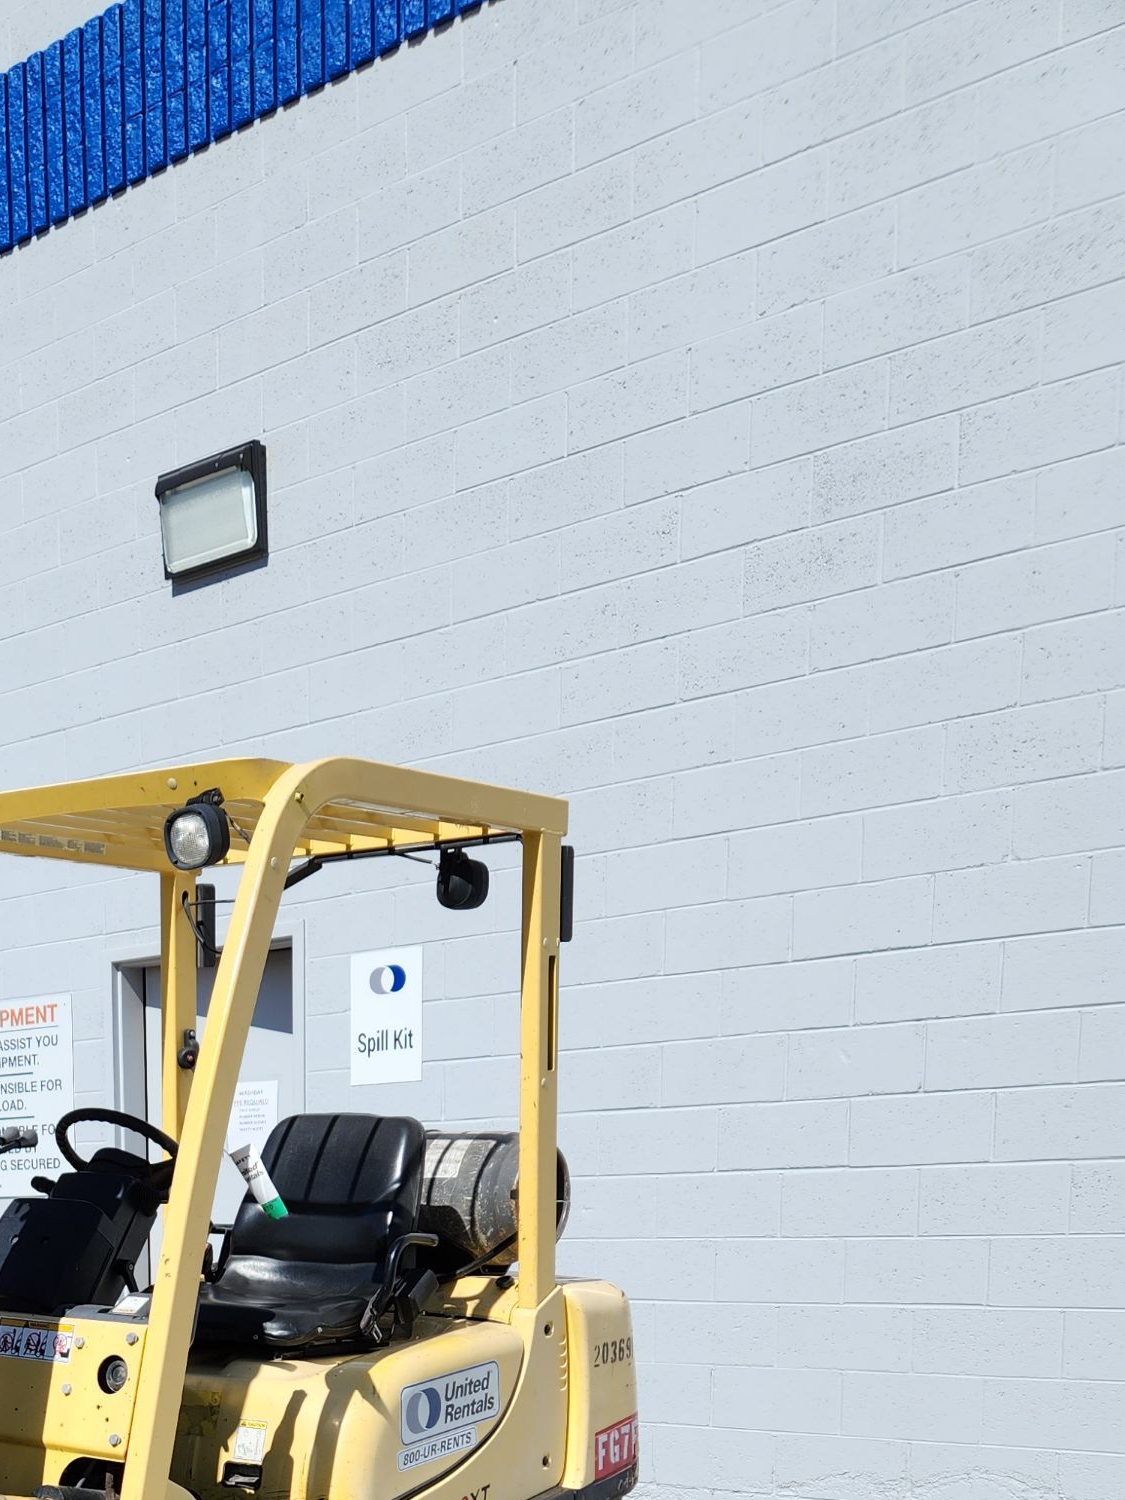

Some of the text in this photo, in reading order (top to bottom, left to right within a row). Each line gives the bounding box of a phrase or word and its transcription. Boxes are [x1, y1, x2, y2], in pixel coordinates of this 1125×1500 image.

[35, 1034, 58, 1048] YOU
[358, 1027, 413, 1058] Spill Kit
[40, 1079, 62, 1092] FOR
[41, 1123, 56, 1136] FO
[10, 1158, 61, 1171] SECURED
[445, 1371, 490, 1402] United
[444, 1393, 495, 1424] Rentals
[403, 1432, 472, 1466] 800-UR-RENTS
